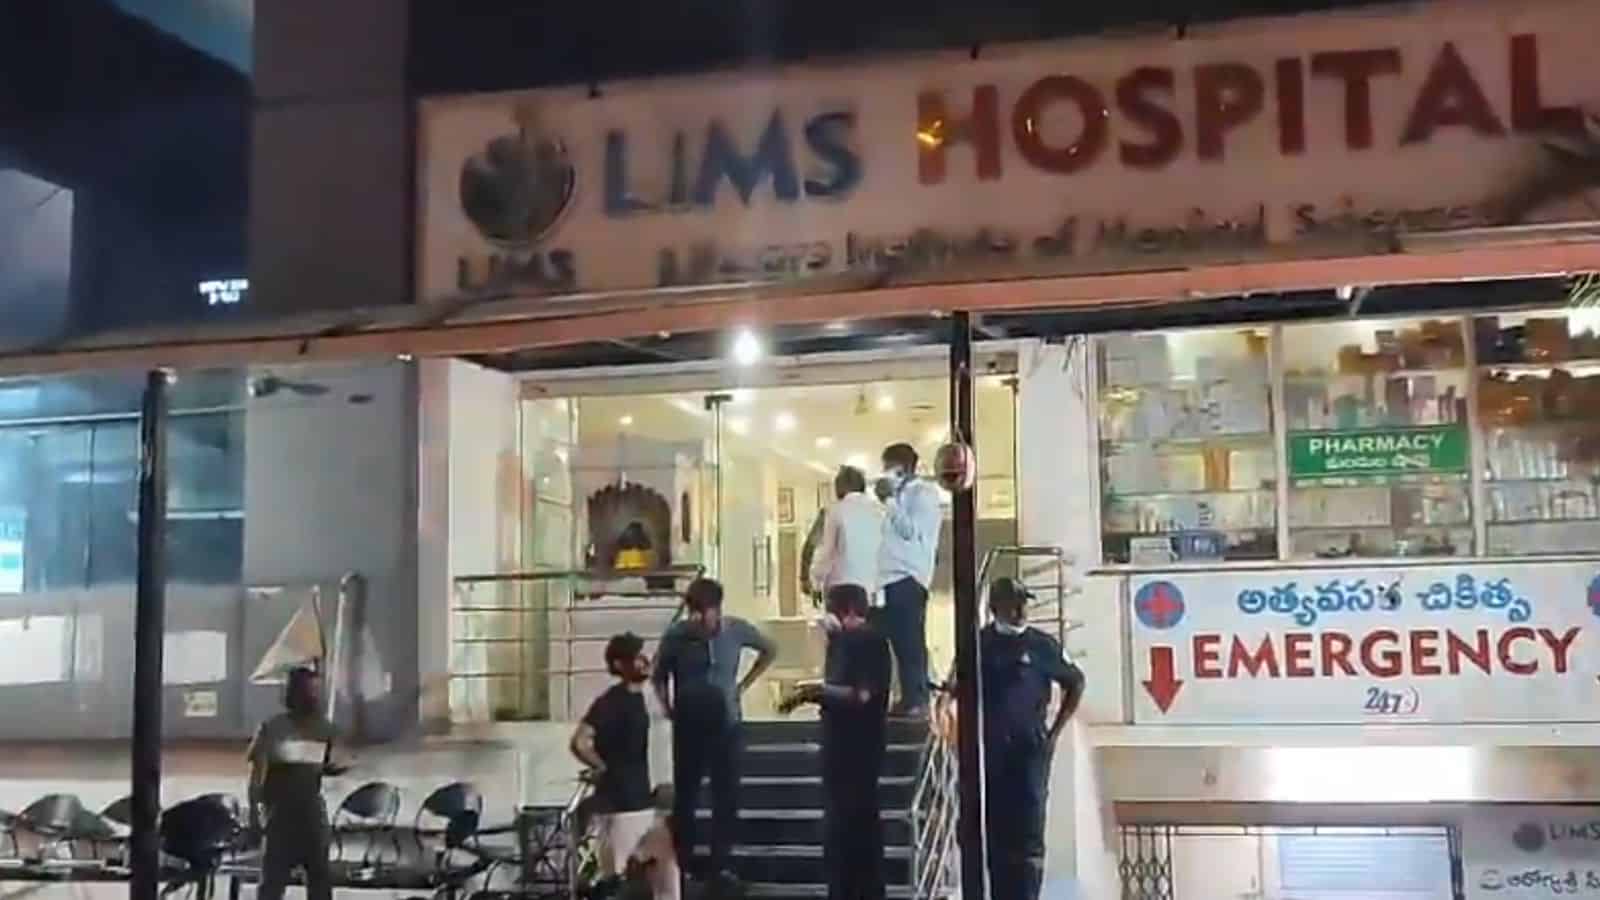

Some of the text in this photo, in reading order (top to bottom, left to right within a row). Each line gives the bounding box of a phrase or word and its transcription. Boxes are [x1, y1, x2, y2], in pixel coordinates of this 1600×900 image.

[604, 33, 1586, 219] LIMS HOSPITAL
[1308, 433, 1446, 456] PHARMACY
[1192, 626, 1581, 680] EMERGENCY
